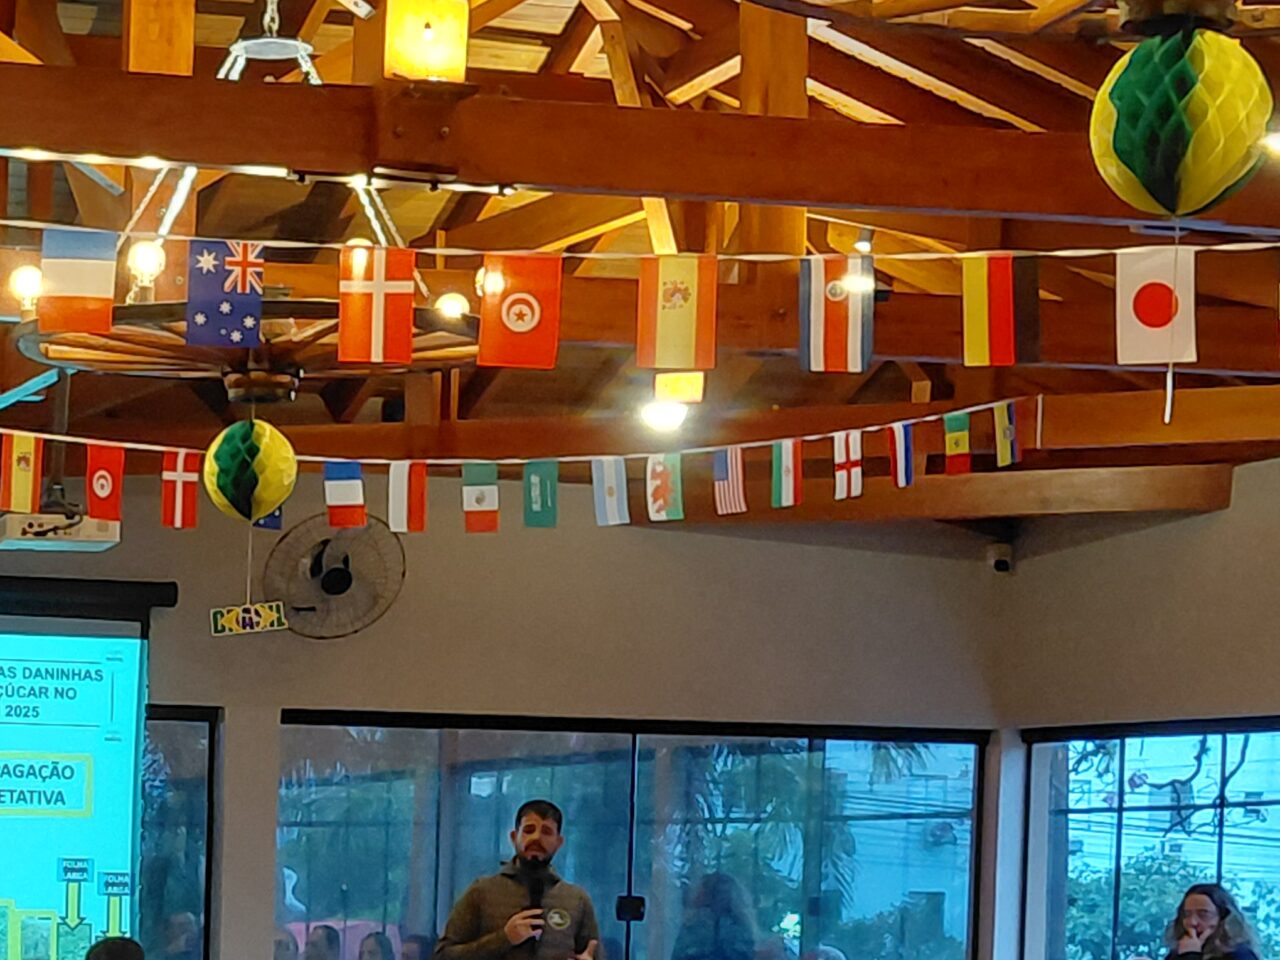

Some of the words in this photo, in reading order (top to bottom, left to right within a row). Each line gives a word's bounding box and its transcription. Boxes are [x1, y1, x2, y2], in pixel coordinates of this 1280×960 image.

[22, 666, 104, 682] DANINHAS
[53, 687, 78, 700] NO
[4, 704, 40, 719] 2025
